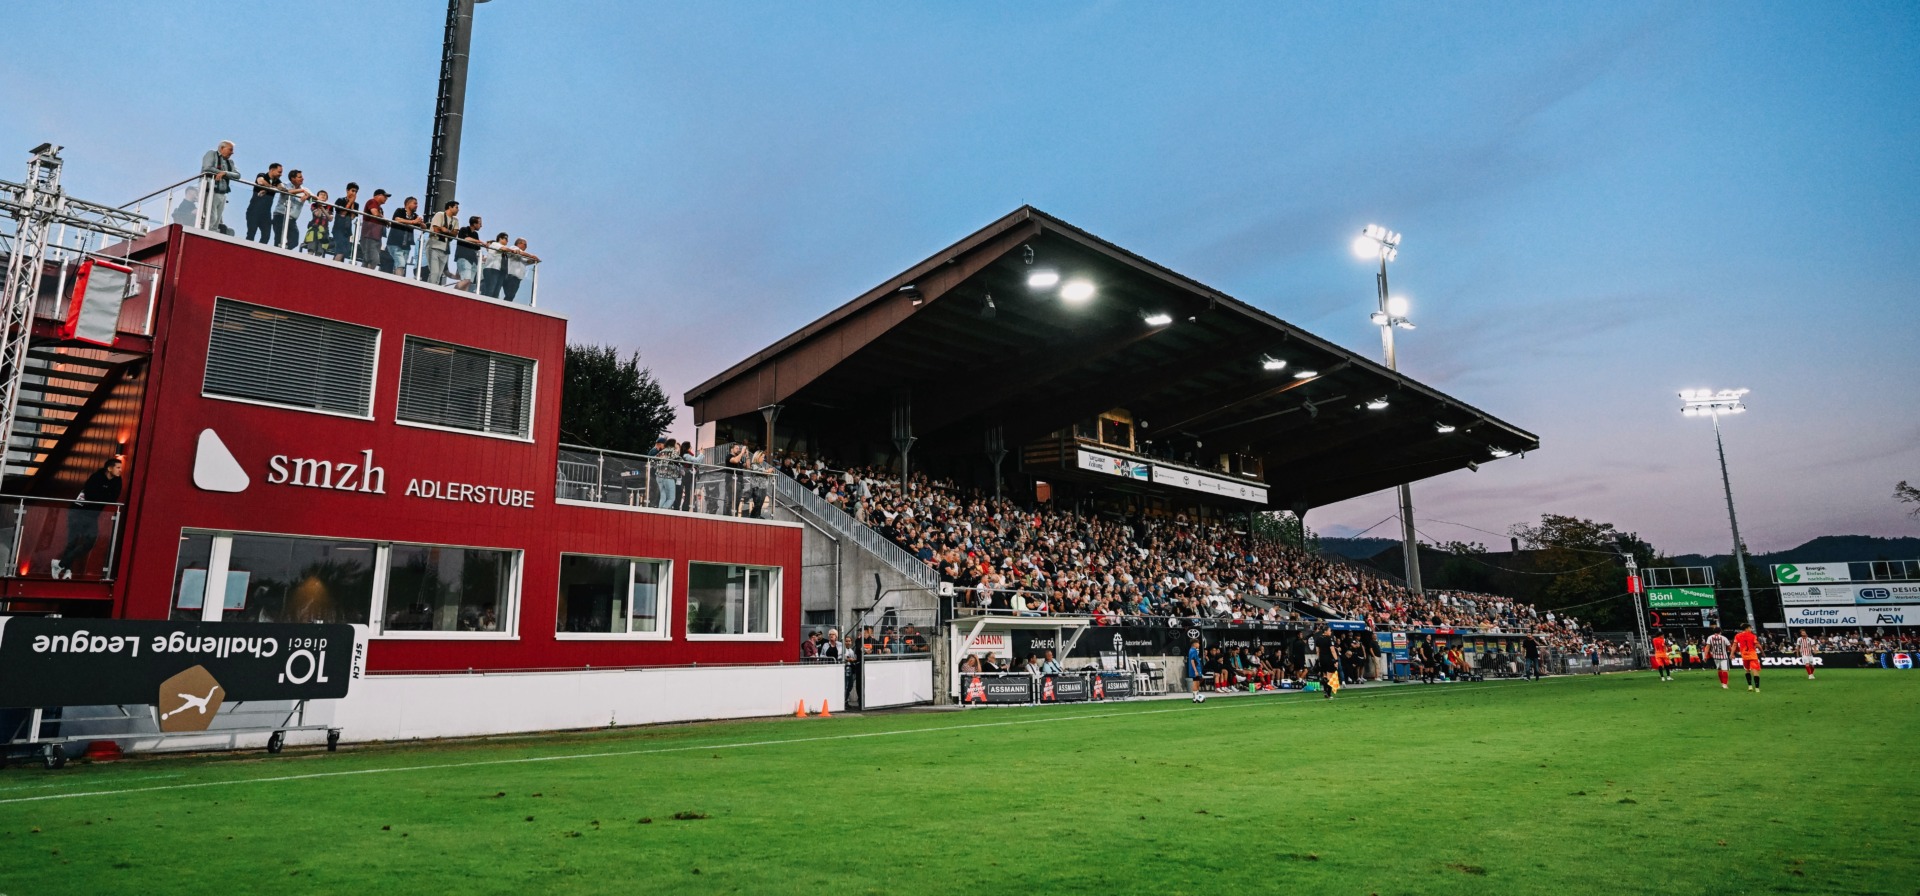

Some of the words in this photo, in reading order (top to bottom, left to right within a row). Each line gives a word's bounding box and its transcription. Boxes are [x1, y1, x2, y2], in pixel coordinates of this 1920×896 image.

[267, 449, 386, 494] smzh
[405, 478, 535, 508] ADLERSTUBE
[1650, 592, 1673, 601] Böni
[1841, 616, 1857, 624] AG
[1876, 613, 1904, 624] AEW
[32, 630, 140, 658] League
[151, 631, 279, 659] Challenge
[288, 638, 328, 651] dieci
[1030, 637, 1047, 649] ZÄME
[352, 642, 363, 680] SFL.CH
[1761, 656, 1824, 666] ZUCKR
[990, 685, 1026, 693] ASSMANN
[1058, 683, 1081, 692] ASSMANN
[1107, 681, 1129, 690] ASSMANN
